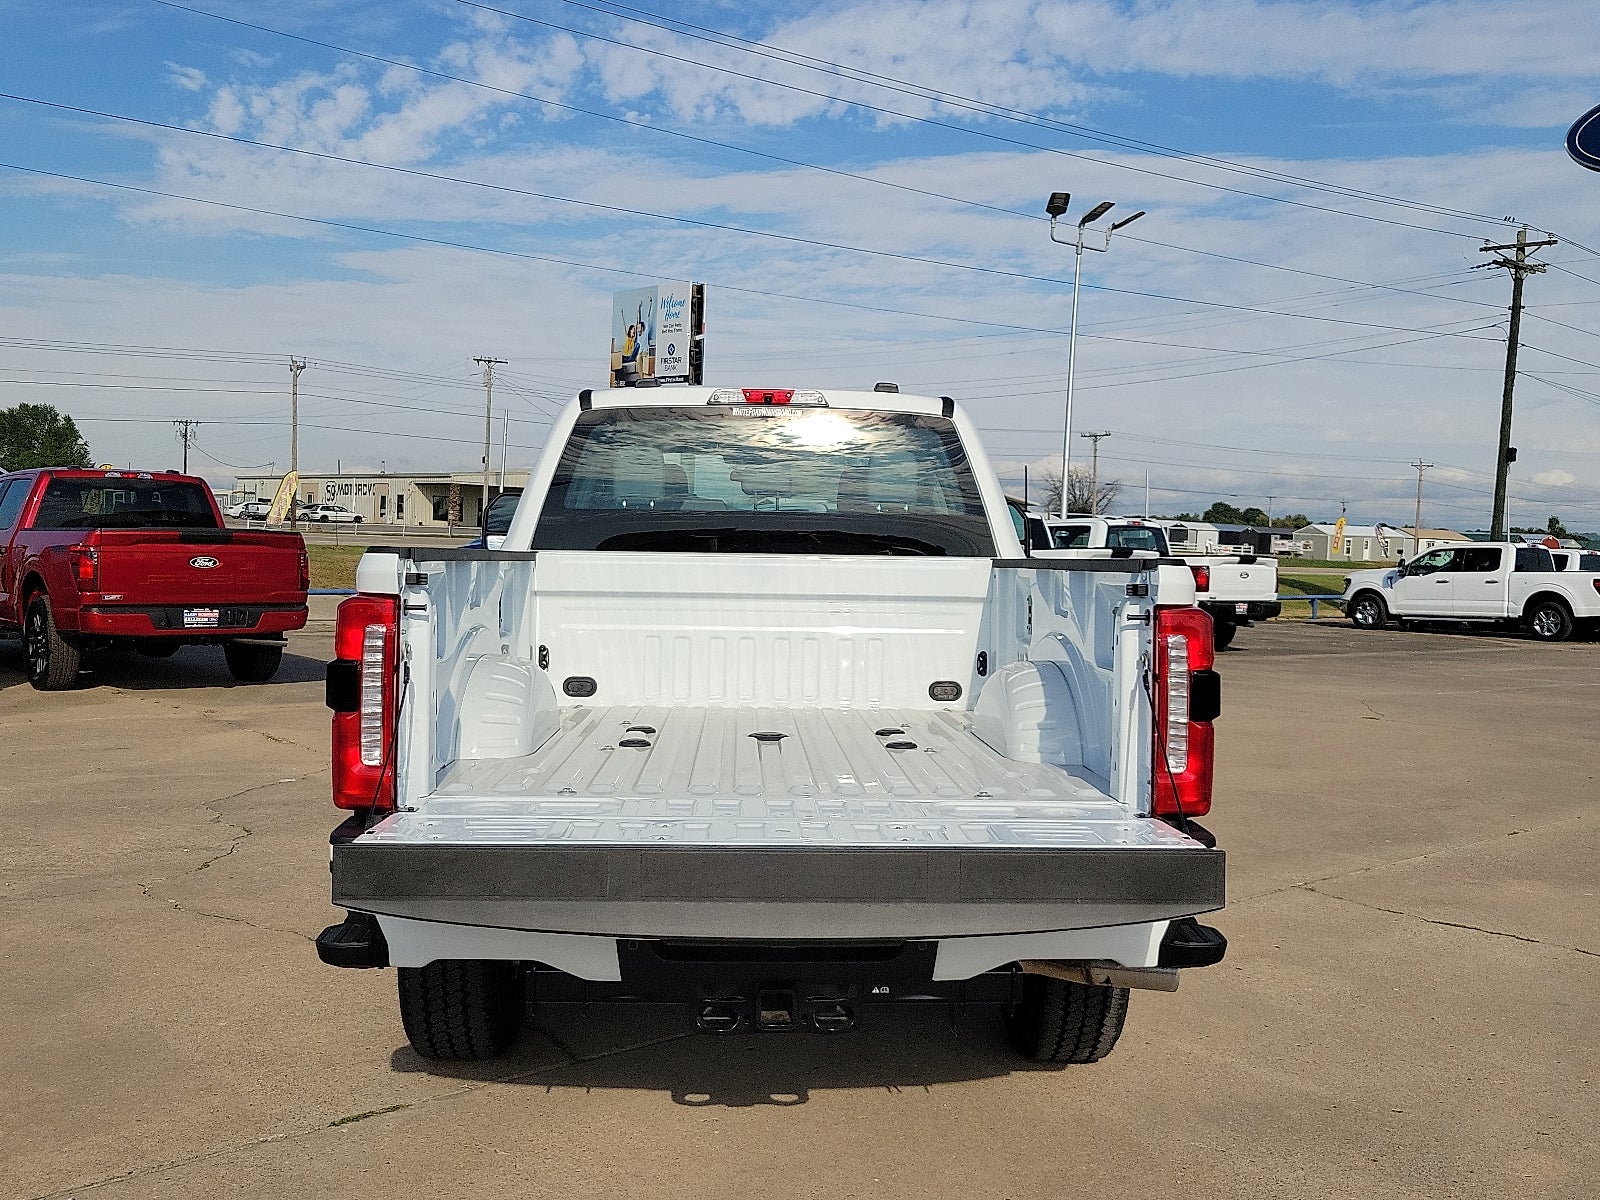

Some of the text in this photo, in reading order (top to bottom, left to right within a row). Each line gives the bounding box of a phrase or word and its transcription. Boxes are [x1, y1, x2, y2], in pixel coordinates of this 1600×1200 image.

[660, 357, 682, 365] FIRSTAR
[326, 484, 336, 502] 59
[194, 558, 215, 567] Ford
